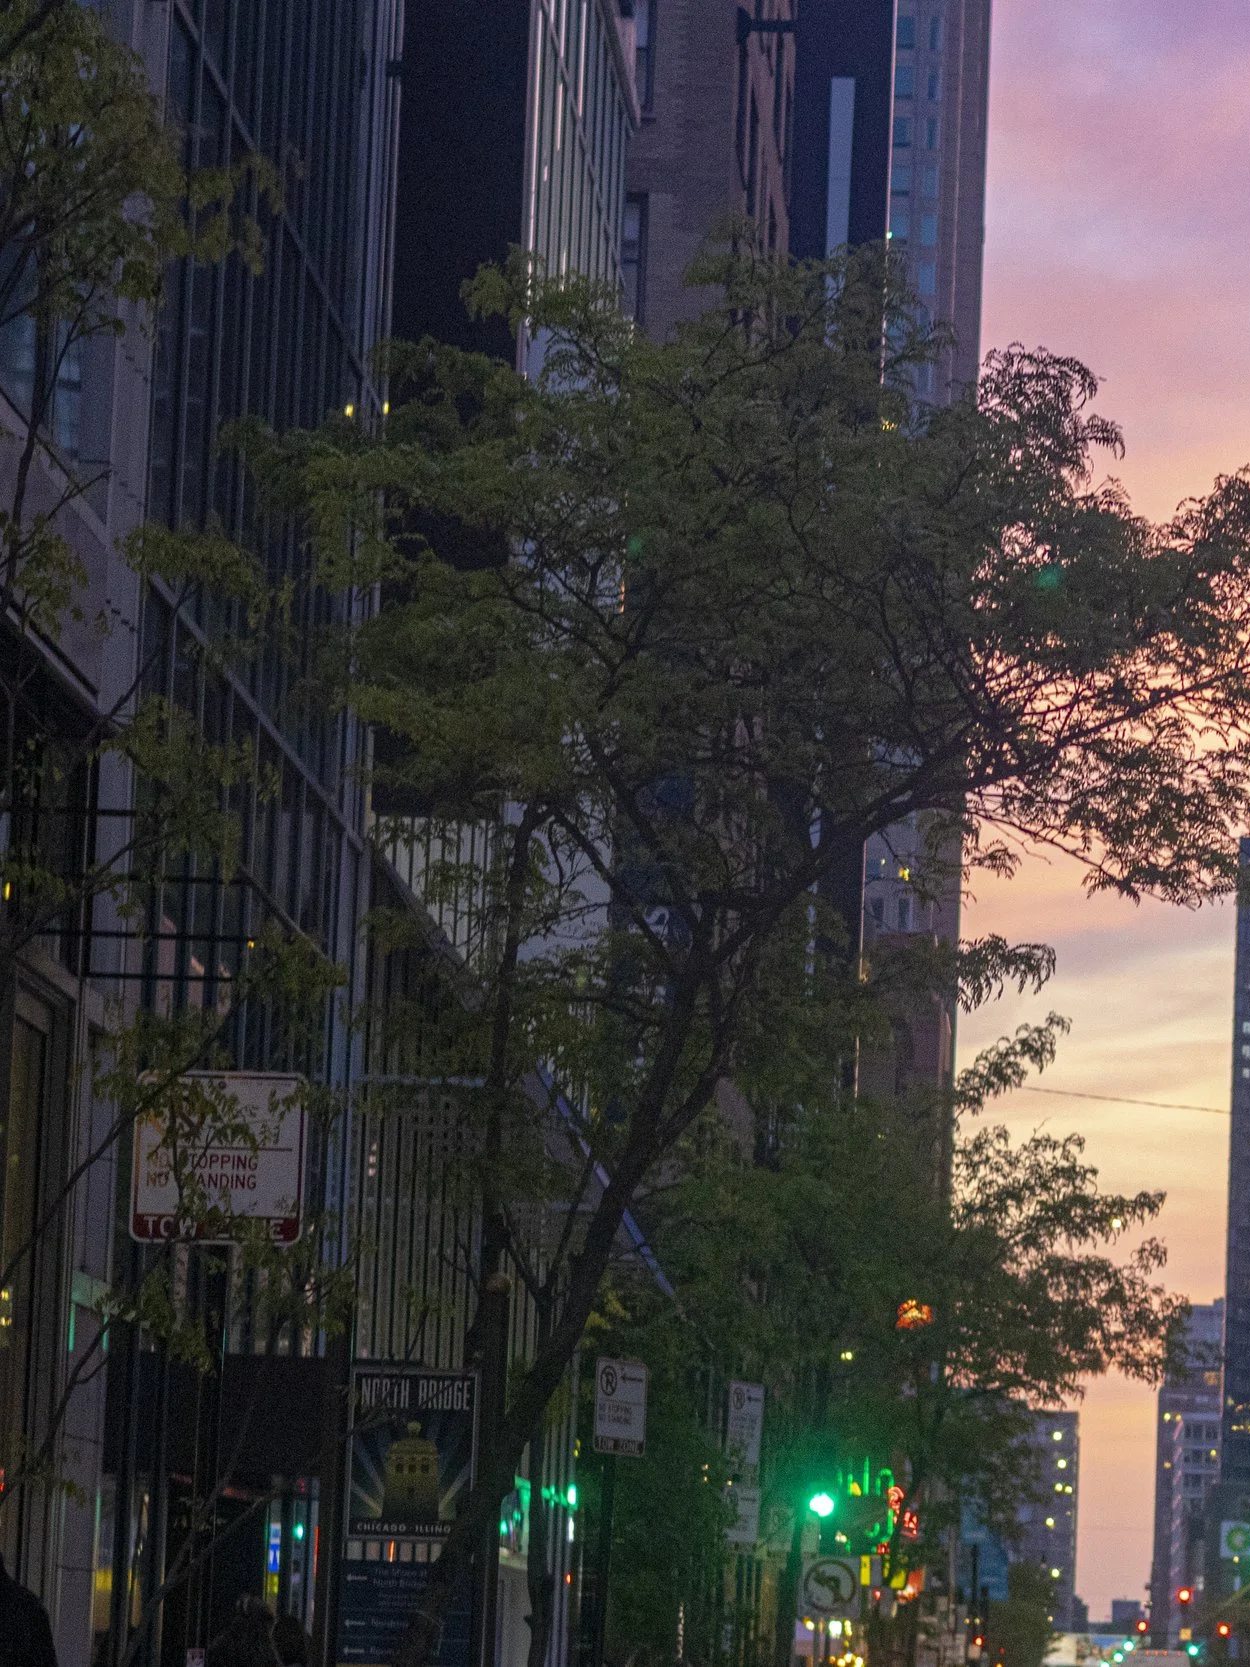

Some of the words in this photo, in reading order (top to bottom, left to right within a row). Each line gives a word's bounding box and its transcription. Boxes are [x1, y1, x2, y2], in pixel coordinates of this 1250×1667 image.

[182, 1153, 259, 1172] TOPPING
[361, 1377, 411, 1410] NORTH
[418, 1379, 472, 1411] BRIDGE
[356, 1522, 407, 1533] CHICAGO
[415, 1523, 452, 1534] ILLINO
